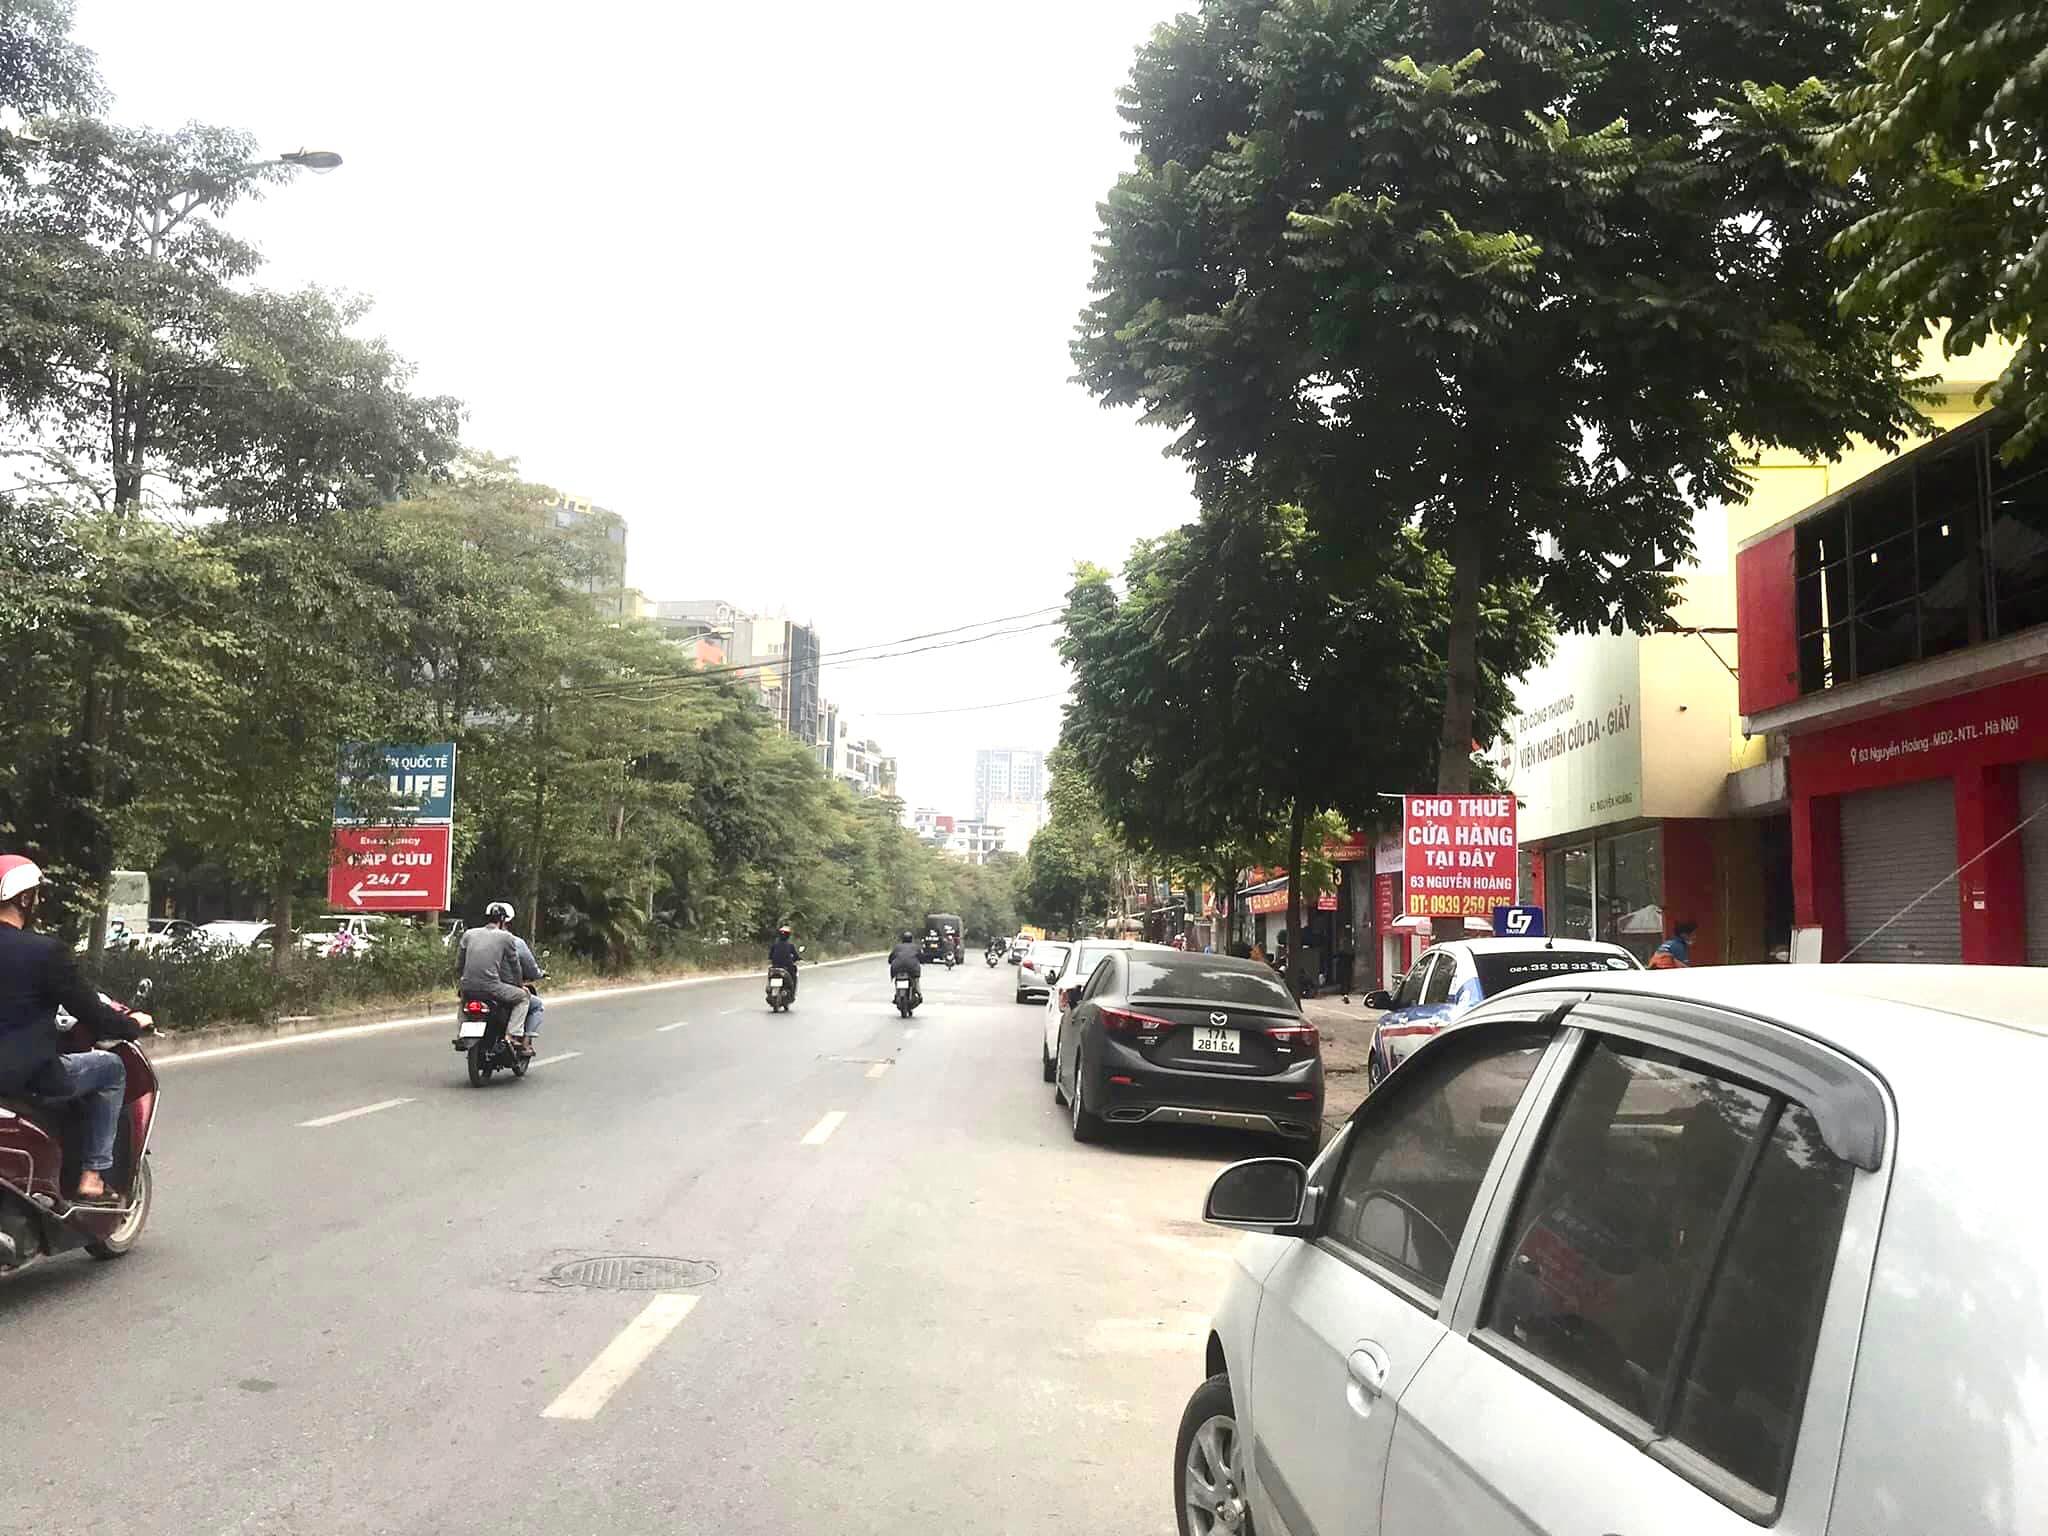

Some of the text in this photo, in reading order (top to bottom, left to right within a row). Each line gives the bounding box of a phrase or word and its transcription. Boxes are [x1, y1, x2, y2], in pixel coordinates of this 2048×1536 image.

[1587, 717, 1600, 744] DA
[402, 754, 432, 770] QUỐC
[1412, 796, 1510, 816] CHO THUÊ
[1408, 820, 1513, 846] CỬA HÀNG
[1425, 850, 1454, 869] TẠI
[1458, 848, 1496, 867] ĐÂY
[367, 873, 411, 885] 24/7
[1410, 876, 1424, 888] 63
[1431, 895, 1460, 913] 0939
[1463, 896, 1486, 913] 259
[1507, 910, 1532, 934] G7
[1530, 963, 1548, 971] 32
[1208, 1029, 1227, 1040] 17A
